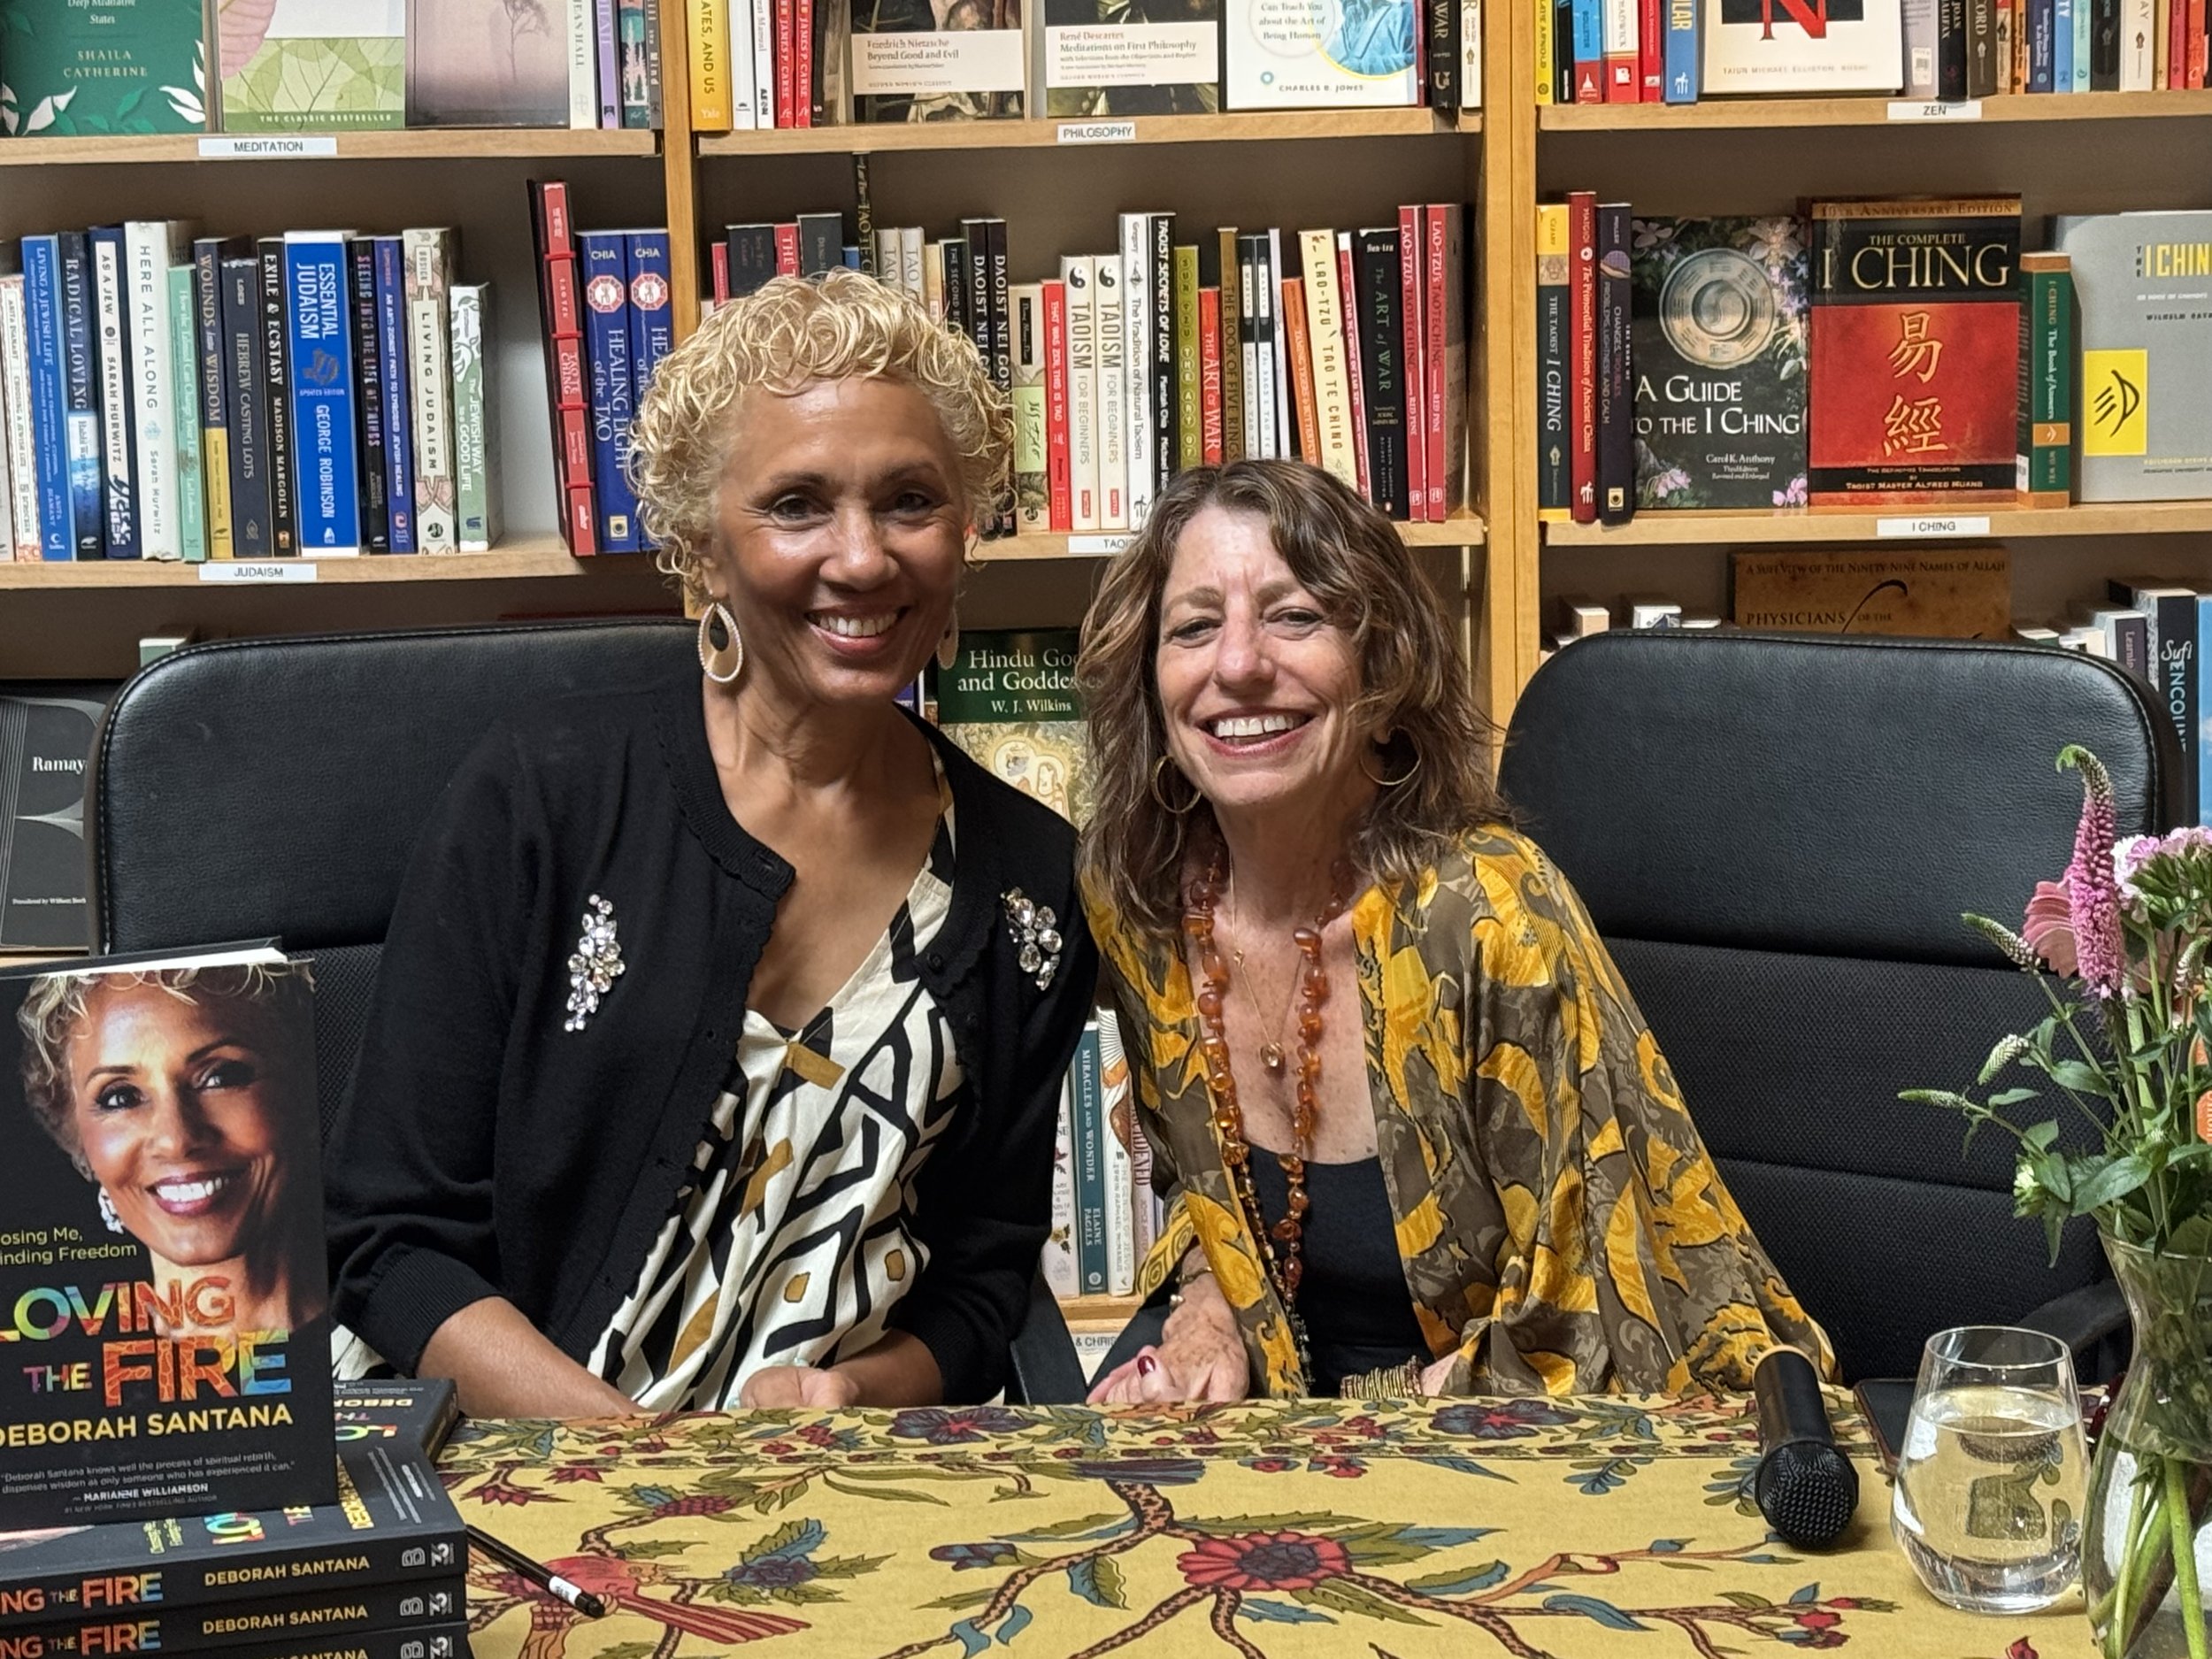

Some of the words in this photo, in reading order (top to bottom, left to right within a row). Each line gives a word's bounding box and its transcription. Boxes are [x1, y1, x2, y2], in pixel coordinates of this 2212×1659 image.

[779, 19, 789, 53] JAMES
[63, 66, 148, 79] CATHERINE
[78, 50, 132, 62] SHAILA
[702, 42, 715, 73] AND
[704, 77, 716, 95] US
[780, 65, 789, 100] CARSE
[1923, 105, 1947, 116] ZEN
[234, 142, 303, 152] MEDITATION
[1063, 127, 1132, 138] PHILOSOPHY
[1857, 204, 1953, 217] ANNIVERSARY
[1957, 203, 2013, 213] EDITION
[590, 249, 617, 261] CHIA
[634, 247, 660, 259] CHIA
[1157, 219, 1169, 259] TAOIST
[1868, 234, 1893, 246] THE
[1896, 234, 1966, 246] COMPLETE
[101, 254, 111, 271] AS
[139, 244, 153, 294] HERE
[265, 253, 280, 297] EXILE
[884, 247, 898, 282] TAO
[905, 247, 919, 282] TAO
[1374, 267, 1385, 285] The
[1582, 265, 1593, 281] The
[1823, 248, 1834, 289] I
[1851, 243, 2010, 290] CHING
[2146, 244, 2152, 277] I
[2156, 243, 2210, 277] CHIN
[104, 274, 112, 284] A
[198, 253, 216, 327] WOUNDS
[973, 255, 987, 317] DAOIST
[1158, 261, 1169, 313] SECRETS
[1314, 261, 1332, 326] LAO-TZU
[66, 257, 84, 339] RADICAL
[104, 287, 113, 316] JEW
[266, 302, 280, 314] &
[296, 262, 319, 340] JUDAISM
[318, 263, 340, 341] ESSENTIAL
[1131, 297, 1142, 318] The
[1223, 285, 1235, 312] THE
[1375, 290, 1390, 328] ART
[1548, 296, 1558, 317] THE
[1582, 282, 1593, 333] Primordial
[142, 302, 155, 338] ALL
[977, 320, 988, 349] NEI
[1071, 301, 1093, 370] TAOISM
[1100, 300, 1121, 370] TAOISM
[1158, 314, 1170, 331] OF
[1224, 316, 1237, 355] BOOK
[1548, 318, 1558, 356] TAOIST
[267, 320, 283, 386] ECSTASY
[421, 311, 433, 377] LIVING
[1132, 319, 1143, 367] Tradition
[1158, 332, 1170, 364] LOVE
[1204, 331, 1215, 355] THE
[1376, 333, 1387, 345] of
[1582, 334, 1594, 377] Tradition
[70, 342, 88, 410] LOVING
[235, 332, 252, 390] HEBREW
[594, 359, 609, 374] of
[607, 328, 629, 411] HEALING
[1133, 368, 1143, 380] of
[1203, 357, 1219, 392] ART
[1225, 359, 1238, 378] OF
[1322, 345, 1337, 373] TAO
[1377, 349, 1392, 392] WAR
[1546, 357, 1561, 366] I
[106, 356, 118, 398] SARAH
[143, 345, 157, 410] ALONG
[204, 352, 221, 422] WISDOM
[595, 375, 607, 398] the
[1077, 374, 1088, 398] FOR
[1106, 373, 1118, 397] FOR
[1325, 380, 1339, 398] TE
[1580, 377, 1594, 387] of
[1634, 375, 1659, 403] A
[1665, 375, 1743, 403] GUIDE
[1883, 311, 1949, 458] 易經
[1133, 380, 1144, 422] Natural
[1226, 380, 1238, 411] FIVE
[1546, 370, 1562, 432] CHING
[1582, 388, 1594, 424] Ancient
[110, 403, 122, 464] HURWITZ
[240, 392, 253, 444] CASTING
[273, 396, 285, 451] MADISON
[315, 403, 334, 455] GEORGE
[425, 386, 437, 470] JUDAISM
[595, 405, 613, 442] TAO
[1078, 401, 1091, 465] BEGINNERS
[1106, 400, 1119, 464] BEGINNERS
[1204, 408, 1221, 452] WAR
[1327, 405, 1343, 449] CHING
[1658, 416, 1698, 434] THE
[1705, 407, 1713, 434] I
[1720, 407, 1801, 434] CHING
[612, 416, 634, 470] LIGHT
[1133, 423, 1144, 460] Taoism
[1227, 416, 1239, 460] RINGS
[1582, 424, 1594, 453] China
[242, 446, 255, 479] LOTS
[1706, 453, 1729, 464] Carol
[1729, 453, 1738, 464] K.
[1739, 453, 1776, 465] Anthony
[275, 454, 288, 519] MARGOLIN
[319, 457, 336, 519] ROBINSON
[1918, 522, 1956, 532] CHING
[234, 566, 284, 579] JUDAISM
[968, 649, 1034, 669] Hindu
[2160, 639, 2193, 662] Sufi
[957, 672, 995, 692] and
[1002, 670, 1077, 690] Godde
[990, 700, 1009, 713] W.
[1012, 700, 1023, 714] J.
[1025, 699, 1072, 712] Wilkins
[32, 757, 87, 775] Ramay
[1081, 1048, 1094, 1109] MIRACLES
[1085, 1129, 1096, 1183] WONDER
[0, 1226, 48, 1245] osing
[54, 1225, 83, 1242] Me,
[1084, 1207, 1094, 1247] PAGELS
[1092, 1207, 1102, 1246] ELAINE
[0, 1249, 53, 1266] inding
[58, 1242, 138, 1263] Freedom
[0, 1276, 235, 1342] OVING
[22, 1362, 93, 1394] THE
[103, 1327, 292, 1409] FIRE
[147, 1402, 294, 1436] SANTANA
[2, 1482, 48, 1495] dispenses
[50, 1479, 87, 1492] wisdom
[88, 1479, 99, 1487] as
[100, 1476, 122, 1487] only
[123, 1472, 165, 1485] someone
[166, 1471, 187, 1480] who
[188, 1469, 204, 1479] has
[205, 1464, 262, 1479] experienced
[83, 1487, 140, 1502] MARIANNE
[142, 1482, 209, 1497] WILLIAMSON
[49, 1588, 79, 1603] THE
[82, 1571, 164, 1609] FIRE
[204, 1563, 287, 1586] DEBORAH
[291, 1555, 371, 1577] SANTANA
[47, 1636, 77, 1651] THE
[81, 1620, 162, 1656] FIRE
[203, 1613, 284, 1635] DEBORAH
[289, 1604, 369, 1625] SANTANA
